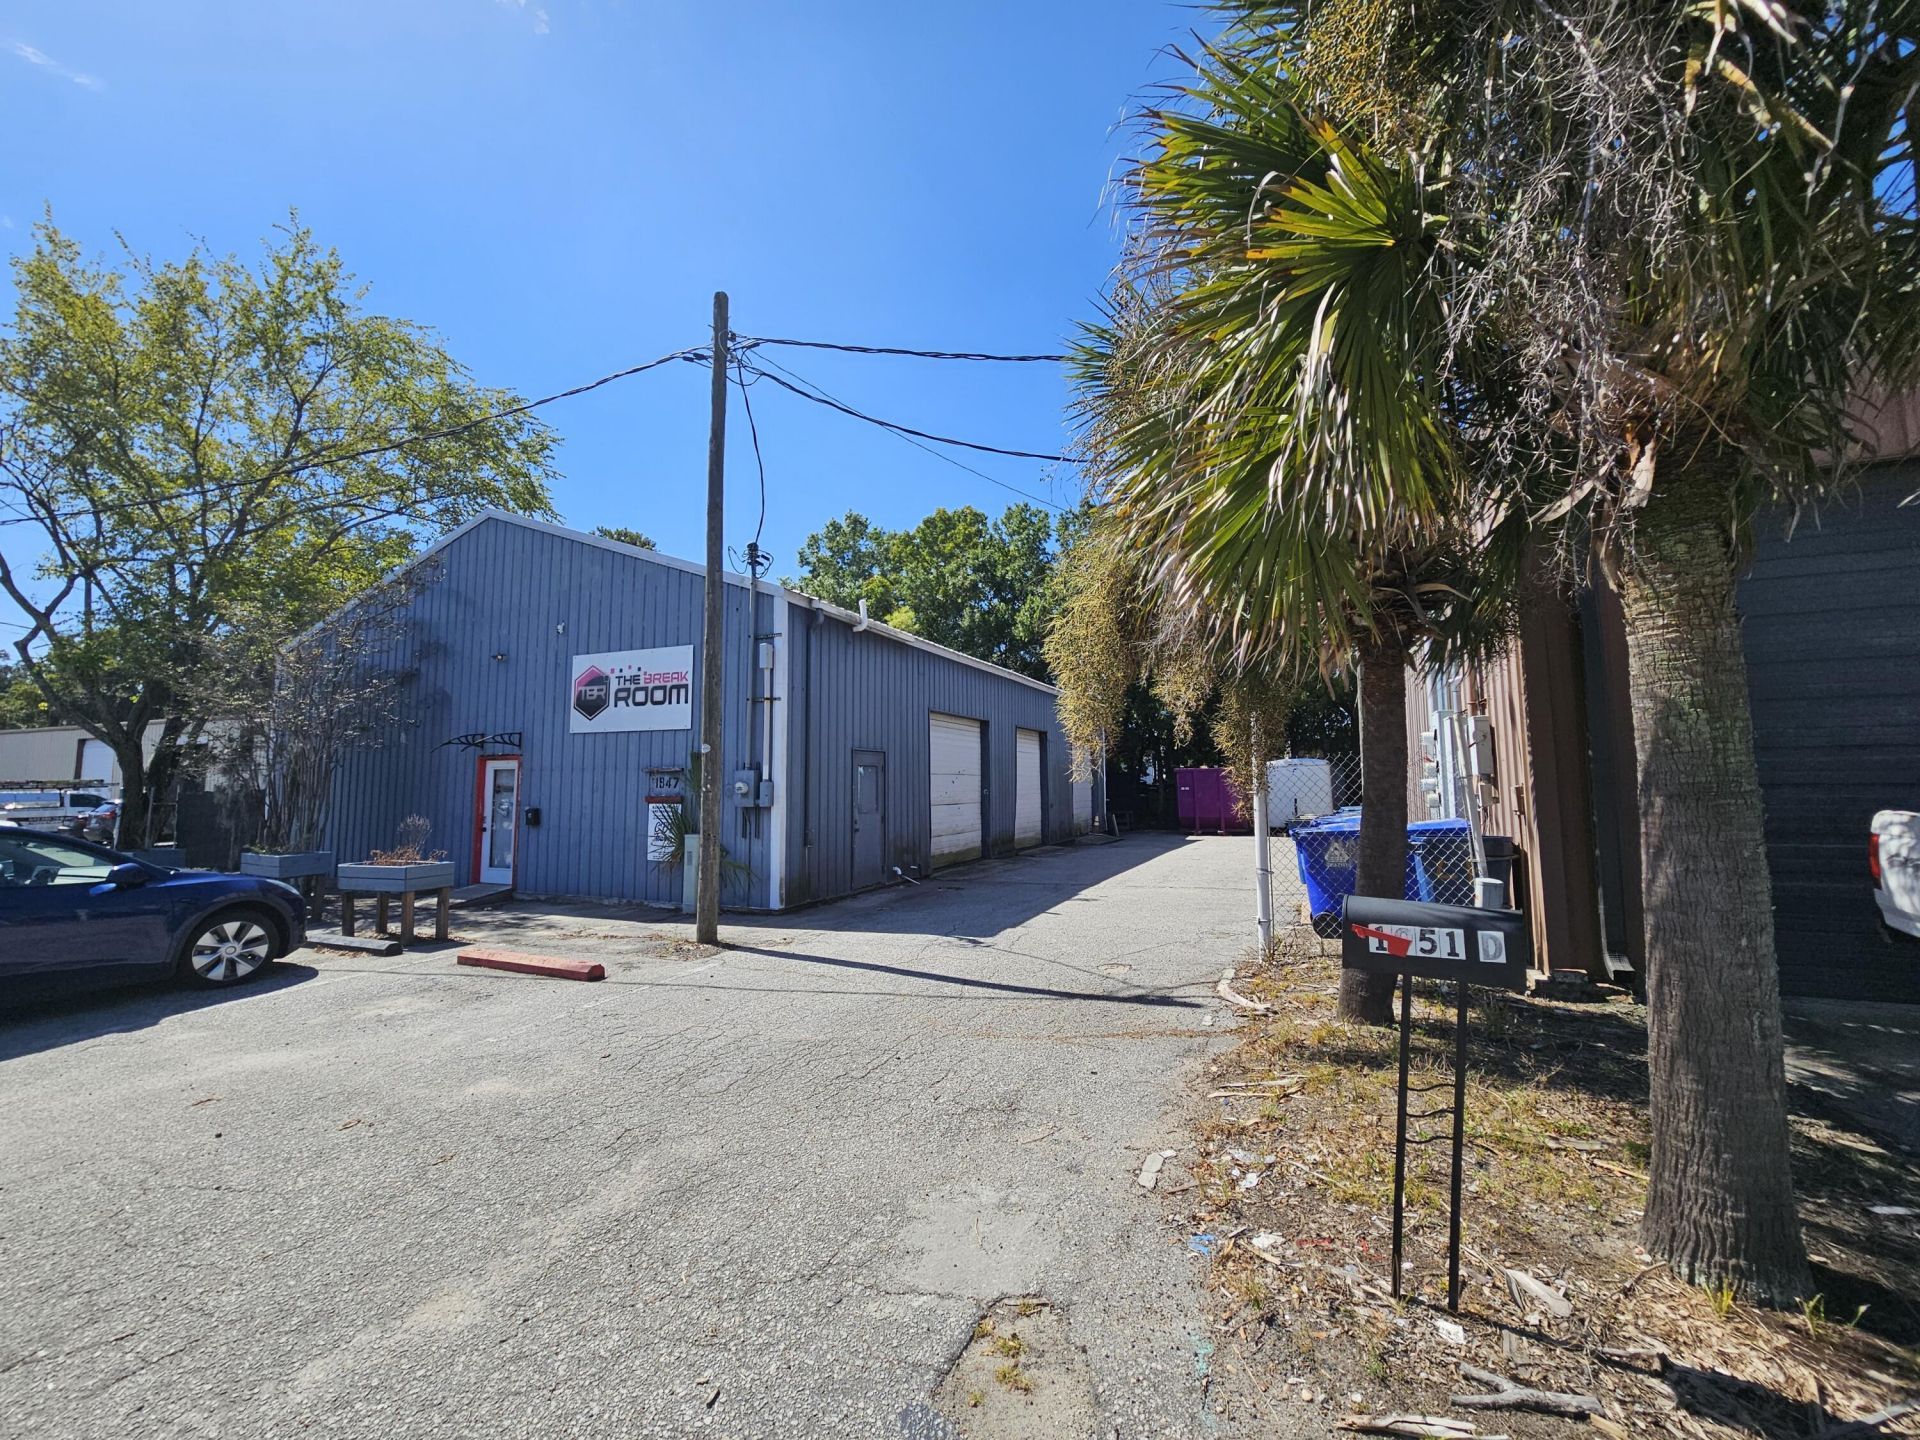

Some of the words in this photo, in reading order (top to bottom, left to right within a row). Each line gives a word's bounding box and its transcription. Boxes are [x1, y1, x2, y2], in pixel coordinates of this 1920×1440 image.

[615, 675, 641, 686] THE
[643, 671, 689, 685] BREAK
[613, 683, 689, 708] ROOM
[1480, 932, 1504, 961] D
